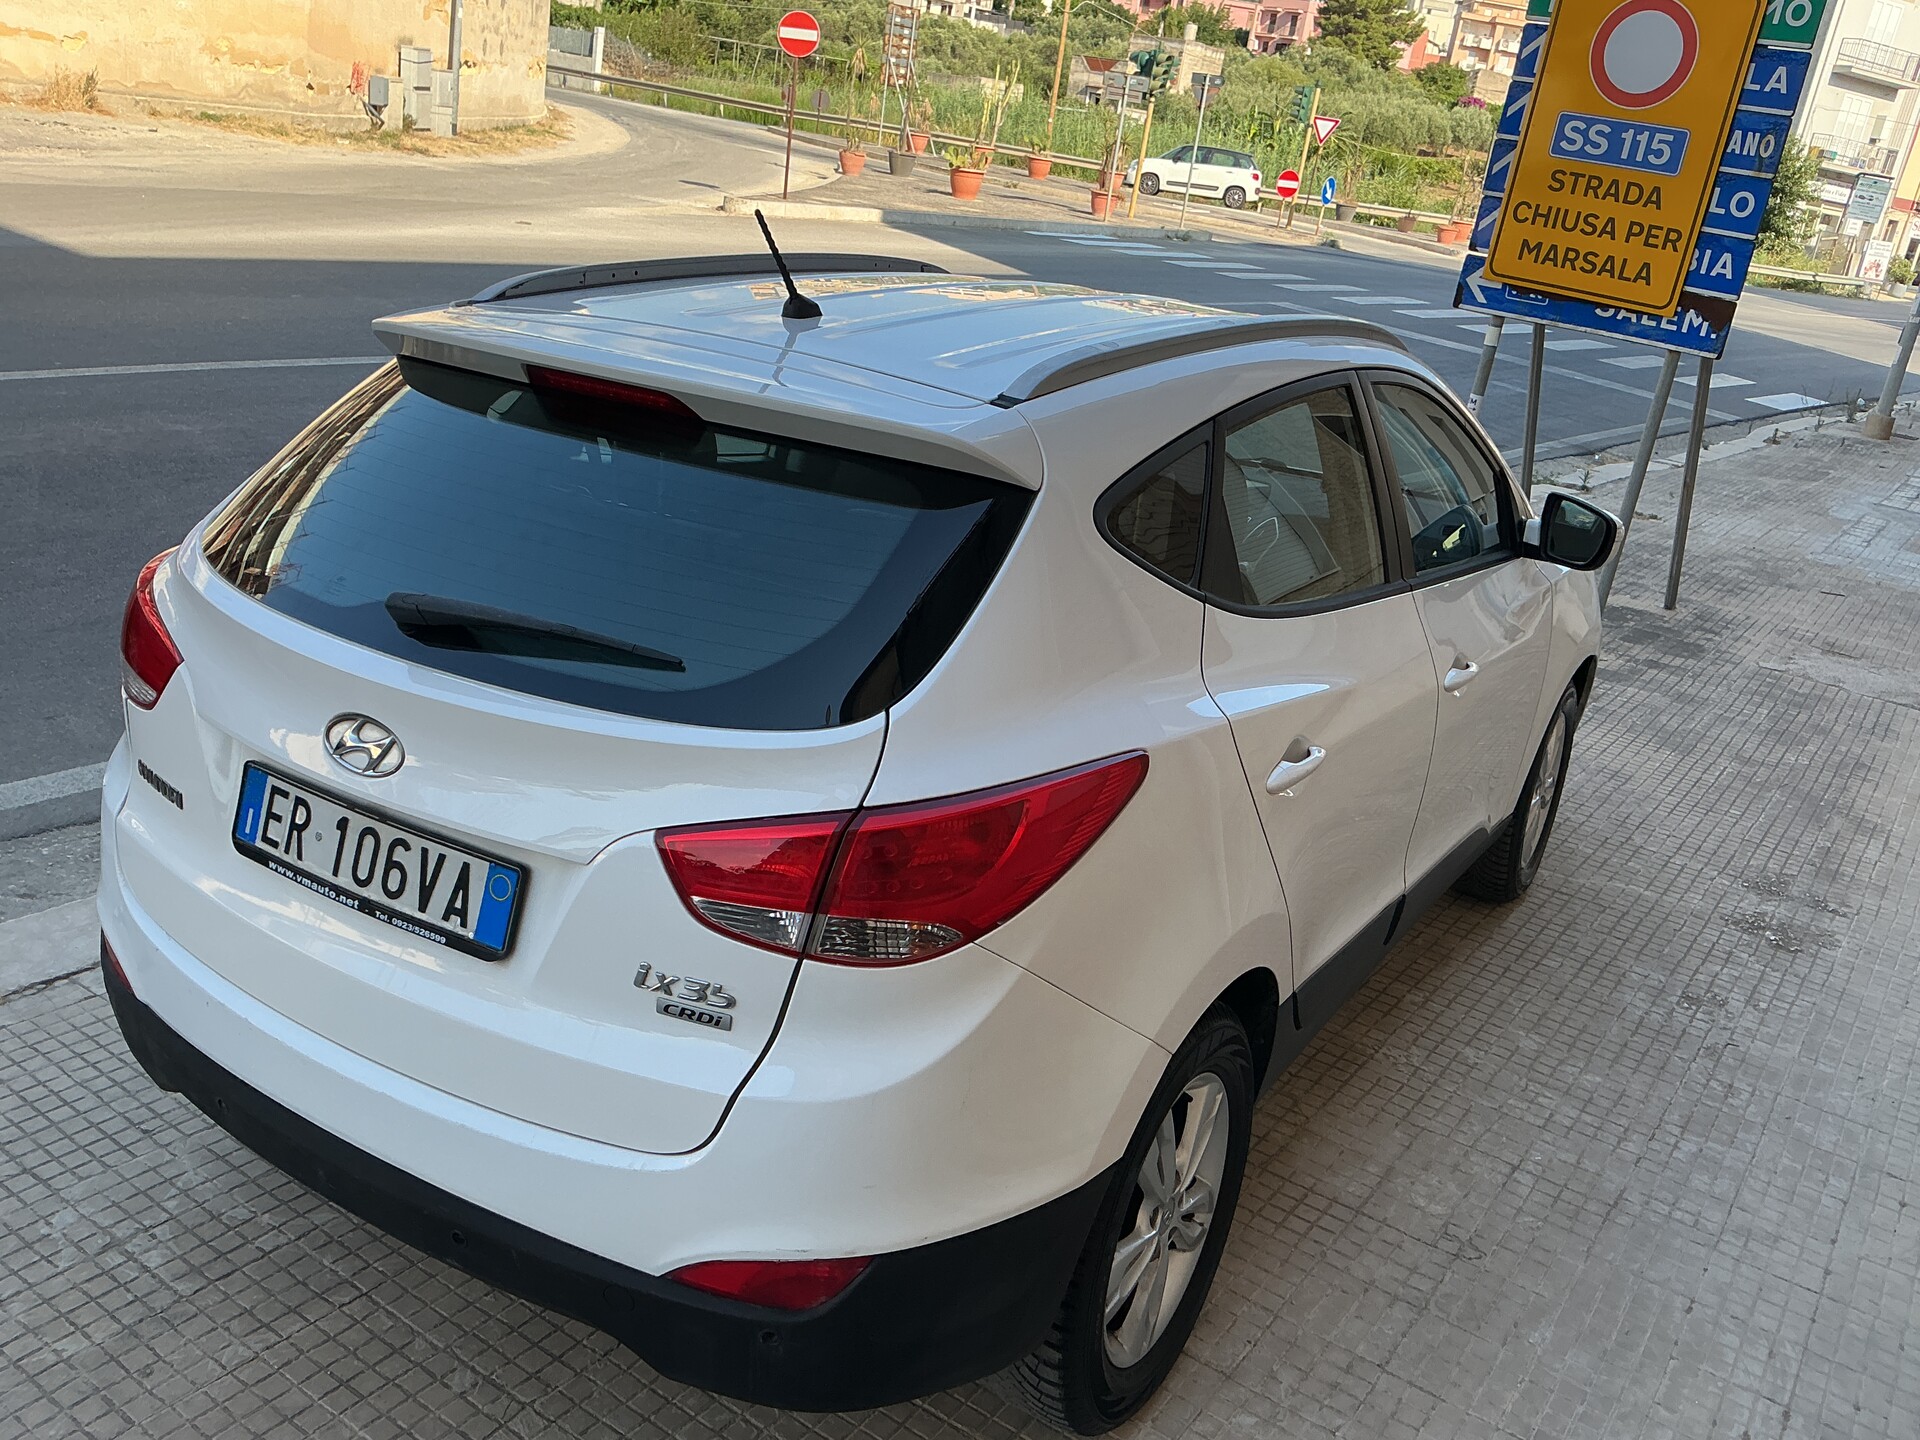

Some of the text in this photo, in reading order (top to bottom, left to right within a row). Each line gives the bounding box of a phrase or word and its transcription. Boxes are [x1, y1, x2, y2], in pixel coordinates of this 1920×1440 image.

[1744, 63, 1787, 94] LA
[1559, 120, 1675, 165] SS 115
[1726, 130, 1775, 158] ANO
[1547, 169, 1662, 211] STRADA
[1709, 187, 1755, 218] LO
[1513, 201, 1683, 252] CHIUSA PER
[1517, 239, 1651, 286] MARSALA
[261, 784, 471, 929] ER 106VA
[268, 860, 360, 910] www.vmauto.net
[375, 910, 390, 923] Tel.
[392, 917, 447, 945] 0923/526599
[663, 1004, 723, 1027] CRDi
